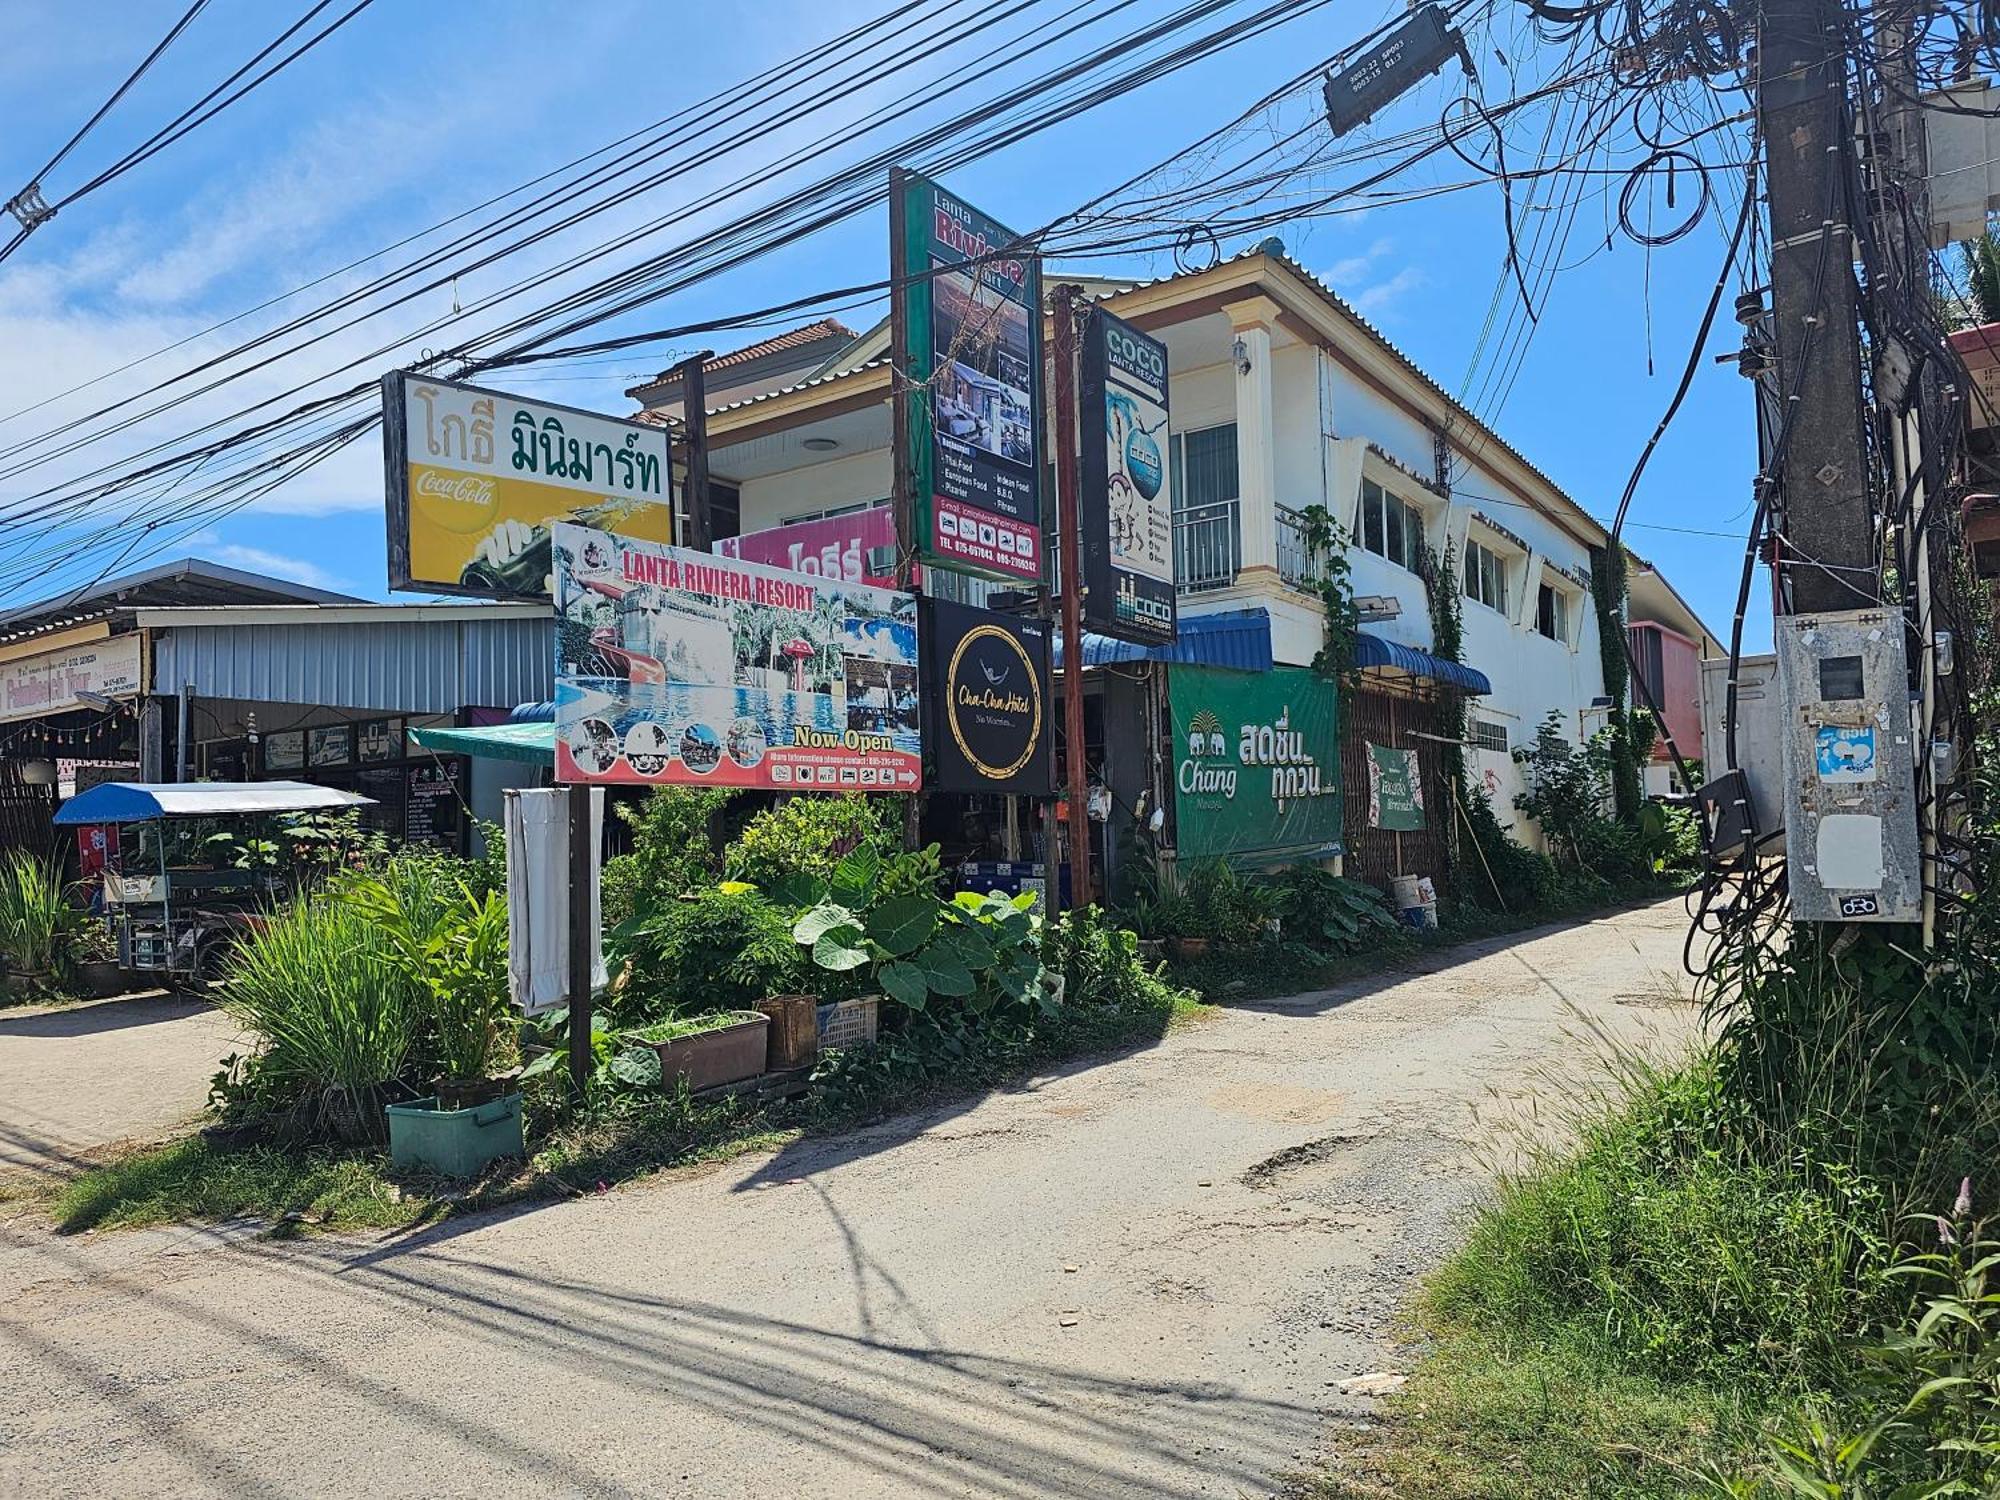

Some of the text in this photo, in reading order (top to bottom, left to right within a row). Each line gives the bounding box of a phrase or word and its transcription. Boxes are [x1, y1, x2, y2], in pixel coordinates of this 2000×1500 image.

[934, 190, 971, 224] Lanta
[1106, 329, 1164, 377] COCO
[1108, 351, 1164, 389] LANTA RESORT
[511, 409, 660, 494] มินิมาร์ท
[416, 470, 496, 505] Coca-Cola
[973, 478, 988, 492] Food
[623, 550, 814, 612] LANTA RIVIERA RESORT
[1135, 597, 1171, 622] COCO
[1004, 691, 1030, 714] Hotel
[794, 726, 893, 753] Now Open
[1179, 760, 1237, 798] Chang
